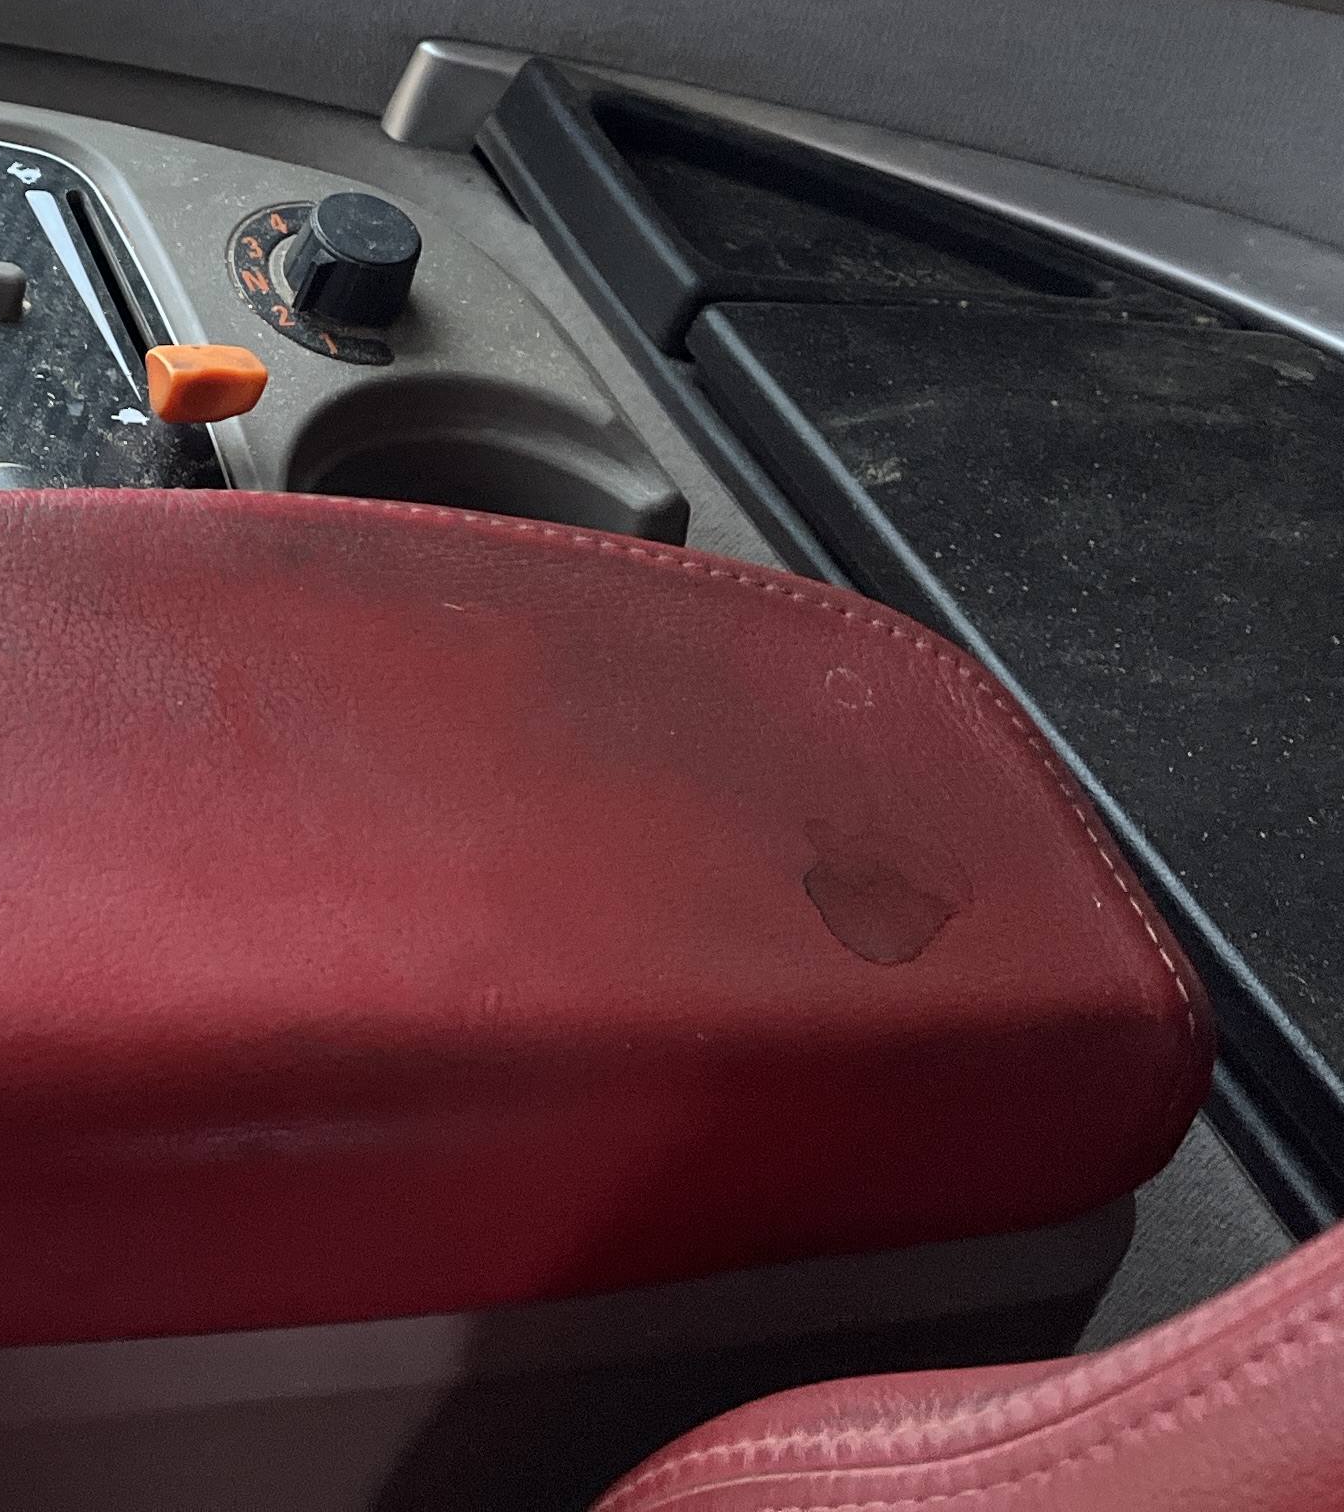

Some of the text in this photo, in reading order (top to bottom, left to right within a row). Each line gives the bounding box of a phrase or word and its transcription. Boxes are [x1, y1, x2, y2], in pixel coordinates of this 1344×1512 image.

[270, 213, 288, 234] 4
[241, 236, 263, 258] 3
[241, 267, 270, 293] N
[271, 305, 296, 326] 2
[319, 332, 338, 354] 1
